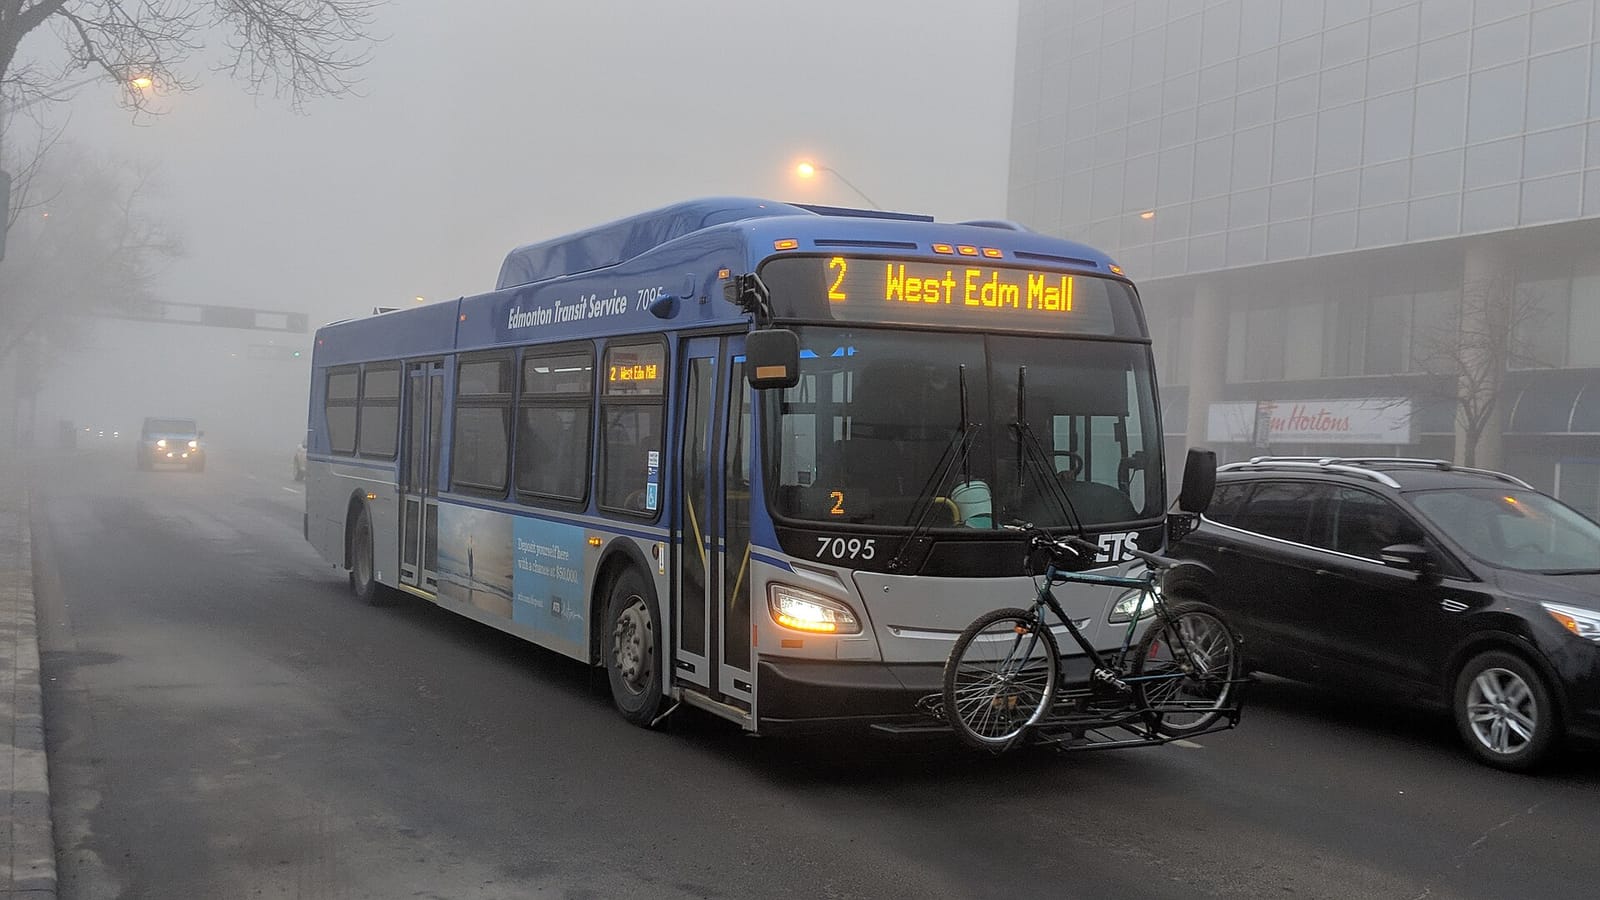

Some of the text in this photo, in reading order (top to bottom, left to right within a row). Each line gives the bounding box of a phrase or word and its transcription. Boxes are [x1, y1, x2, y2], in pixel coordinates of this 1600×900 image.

[828, 257, 1073, 311] 2 West Edm Mall
[507, 305, 552, 330] Edmonton
[553, 295, 587, 323] Transit
[587, 289, 627, 319] Service
[610, 366, 616, 381] 2
[1286, 403, 1349, 432] Hortons
[830, 491, 845, 514] 2
[518, 537, 536, 554] Deposit
[816, 537, 876, 560] 7095
[1096, 531, 1139, 563] ETS
[518, 556, 528, 571] with
[532, 560, 550, 577] chance
